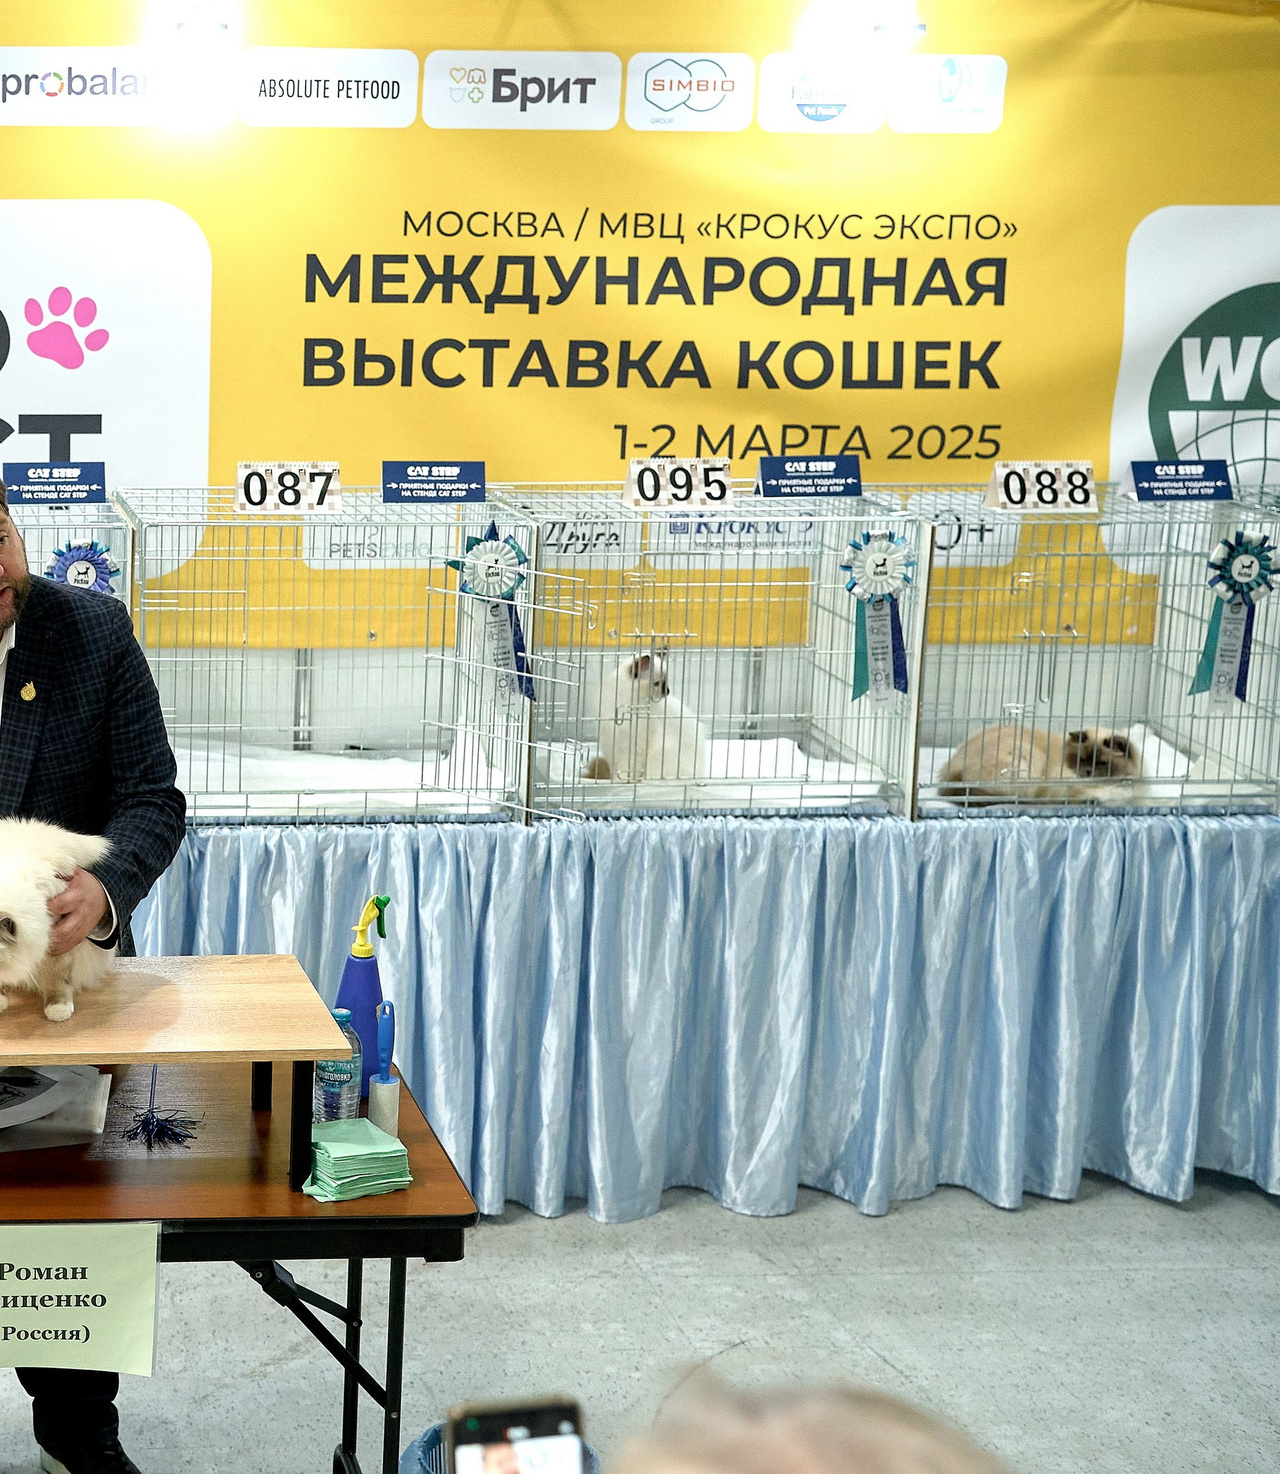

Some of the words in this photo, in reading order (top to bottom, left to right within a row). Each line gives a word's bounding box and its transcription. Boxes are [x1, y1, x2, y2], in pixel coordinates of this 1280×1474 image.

[258, 78, 330, 99] ABSOLUTE
[336, 79, 401, 100] PETFOOD
[492, 68, 596, 112] Брит
[652, 79, 734, 92] SIMBIO
[402, 209, 565, 240] МОСКВА
[574, 207, 590, 242] /
[599, 212, 685, 245] МВЦ
[696, 212, 864, 241] «КРОКУС
[874, 213, 1018, 241] ЭКСПО»
[303, 254, 1007, 316] МЕЖДУНАРОДНАЯ
[302, 338, 711, 389] ВЫСТАВКА
[737, 339, 1001, 390] КОШЕК
[614, 424, 676, 459] 1-2
[696, 424, 872, 460] МАРТА
[888, 424, 1002, 460] 2025
[27, 468, 50, 478] CAT
[52, 468, 81, 478] STEP
[407, 466, 430, 476] CAT
[431, 466, 460, 476] STEP
[636, 466, 728, 501] 095
[784, 461, 807, 472] CAT
[808, 461, 836, 471] STEP
[1154, 465, 1176, 475] CAT
[1177, 464, 1205, 475] STEP
[242, 470, 334, 506] 087
[1002, 470, 1091, 505] 088
